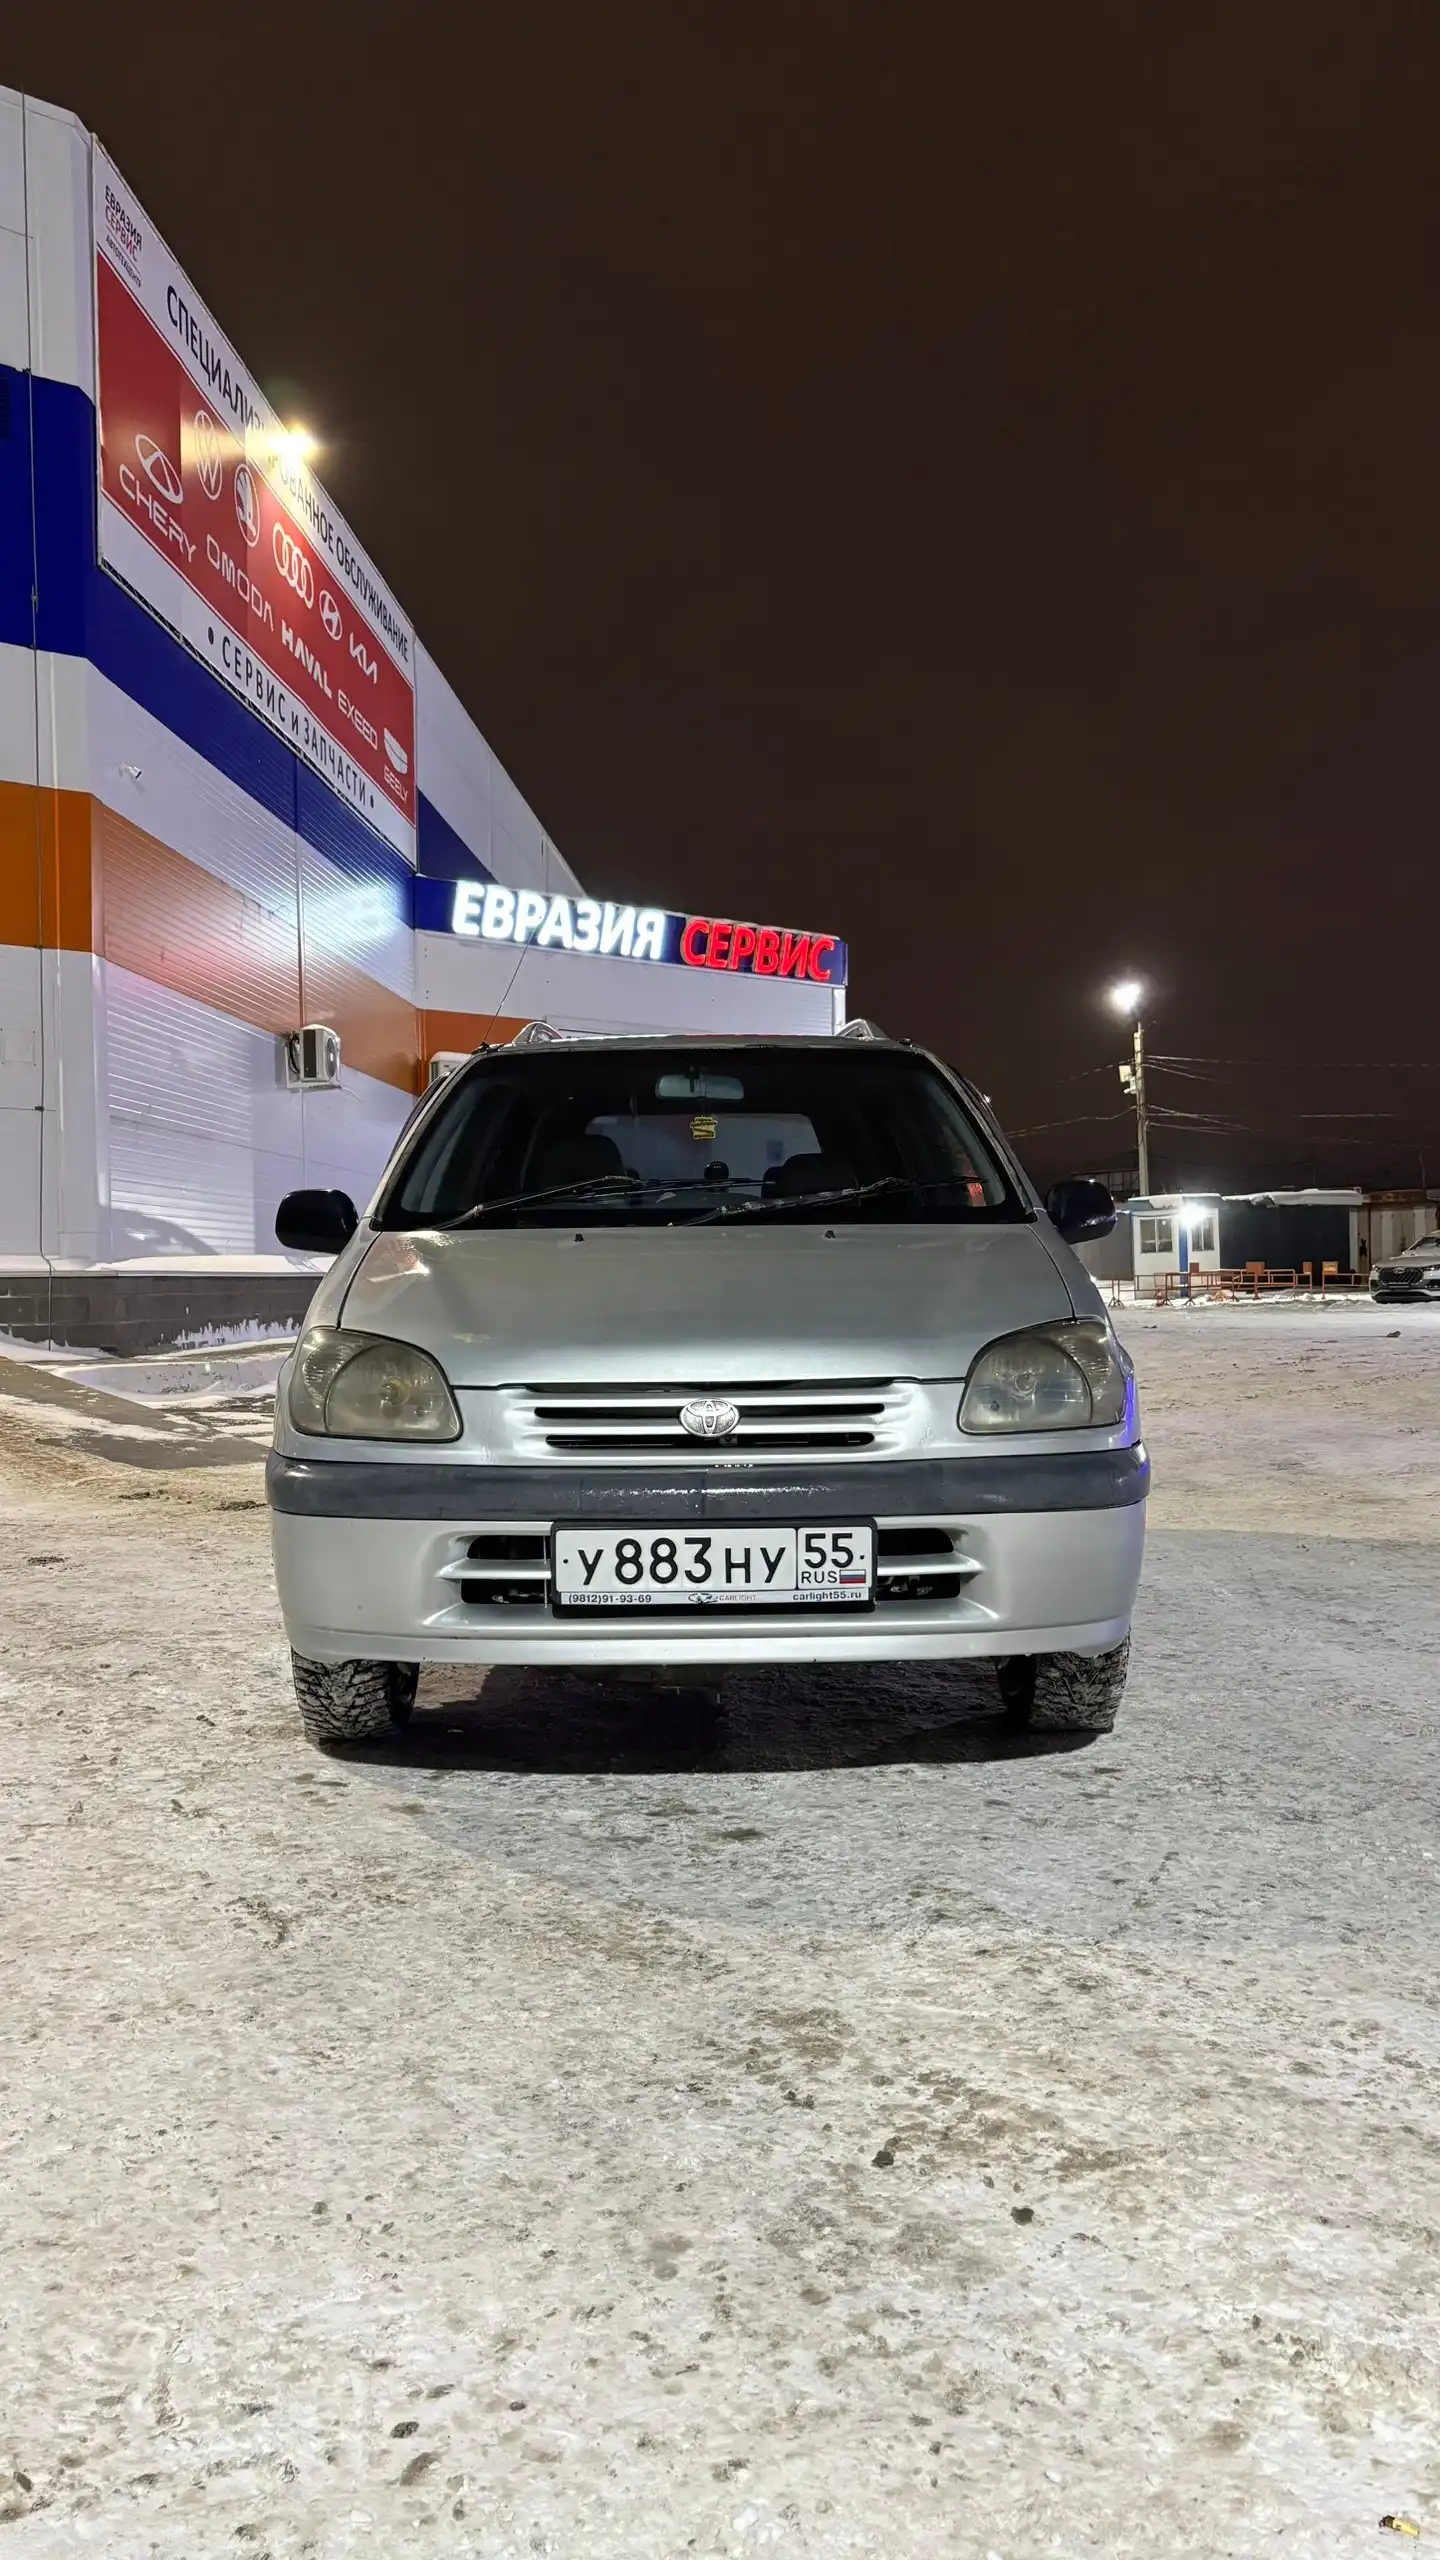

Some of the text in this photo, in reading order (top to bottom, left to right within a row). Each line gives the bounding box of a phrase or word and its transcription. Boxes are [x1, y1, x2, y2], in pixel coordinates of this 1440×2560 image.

[105, 184, 142, 251] ЕВРАЗИЯ
[105, 205, 137, 262] СЕРВИС
[119, 463, 196, 563] CHERY
[206, 533, 274, 632] OMODA
[336, 535, 409, 663] ОБСЛУЖИВАНИЕ
[281, 619, 333, 700] HAVAL
[349, 632, 378, 684] KIA
[222, 635, 286, 723] СЕРВИС
[304, 716, 367, 808] ЗАПЧАСТИ
[338, 688, 378, 751] EXEED
[383, 763, 409, 804] GEELY
[451, 879, 836, 983] ЕВРАЗИЯ СЕРВИС
[800, 1571, 837, 1584] RUS
[804, 1532, 854, 1568] 55
[568, 1593, 652, 1604] (9812)91-93-69
[792, 1590, 862, 1602] carlight55.ru
